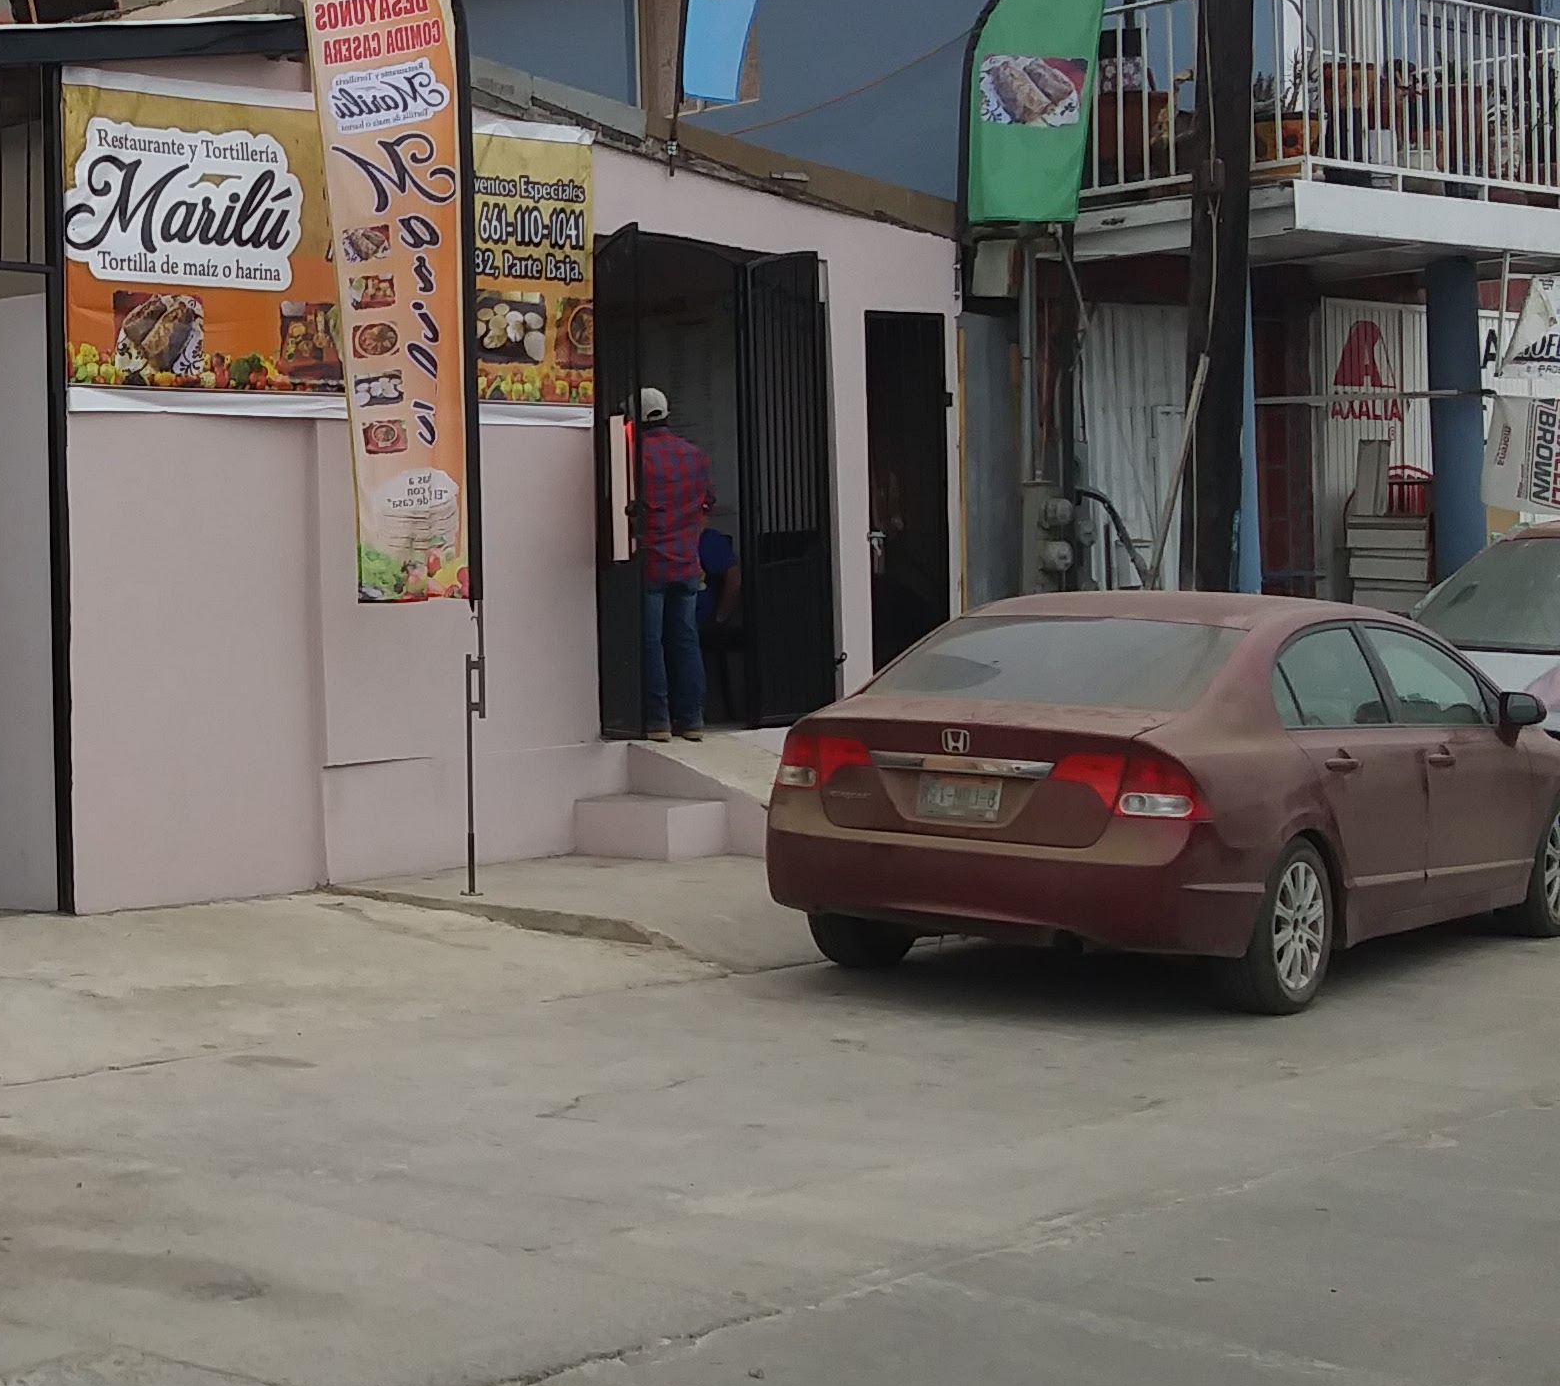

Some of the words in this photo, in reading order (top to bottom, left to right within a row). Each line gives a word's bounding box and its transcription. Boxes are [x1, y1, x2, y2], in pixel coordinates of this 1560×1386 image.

[95, 128, 185, 156] Restaurante
[187, 144, 198, 162] y
[201, 139, 279, 163] Tortillería
[65, 154, 293, 254] Marilú
[474, 176, 516, 195] ventos
[520, 177, 585, 201] Especiales
[479, 205, 585, 247] 661-110-1041
[97, 250, 157, 274] Tortilla
[160, 255, 179, 275] de
[182, 258, 219, 278] maíz
[222, 266, 232, 279] o
[235, 259, 282, 282] harina
[503, 252, 542, 277] Parte
[545, 254, 584, 282] Baja.
[1532, 410, 1557, 502] BROWN
